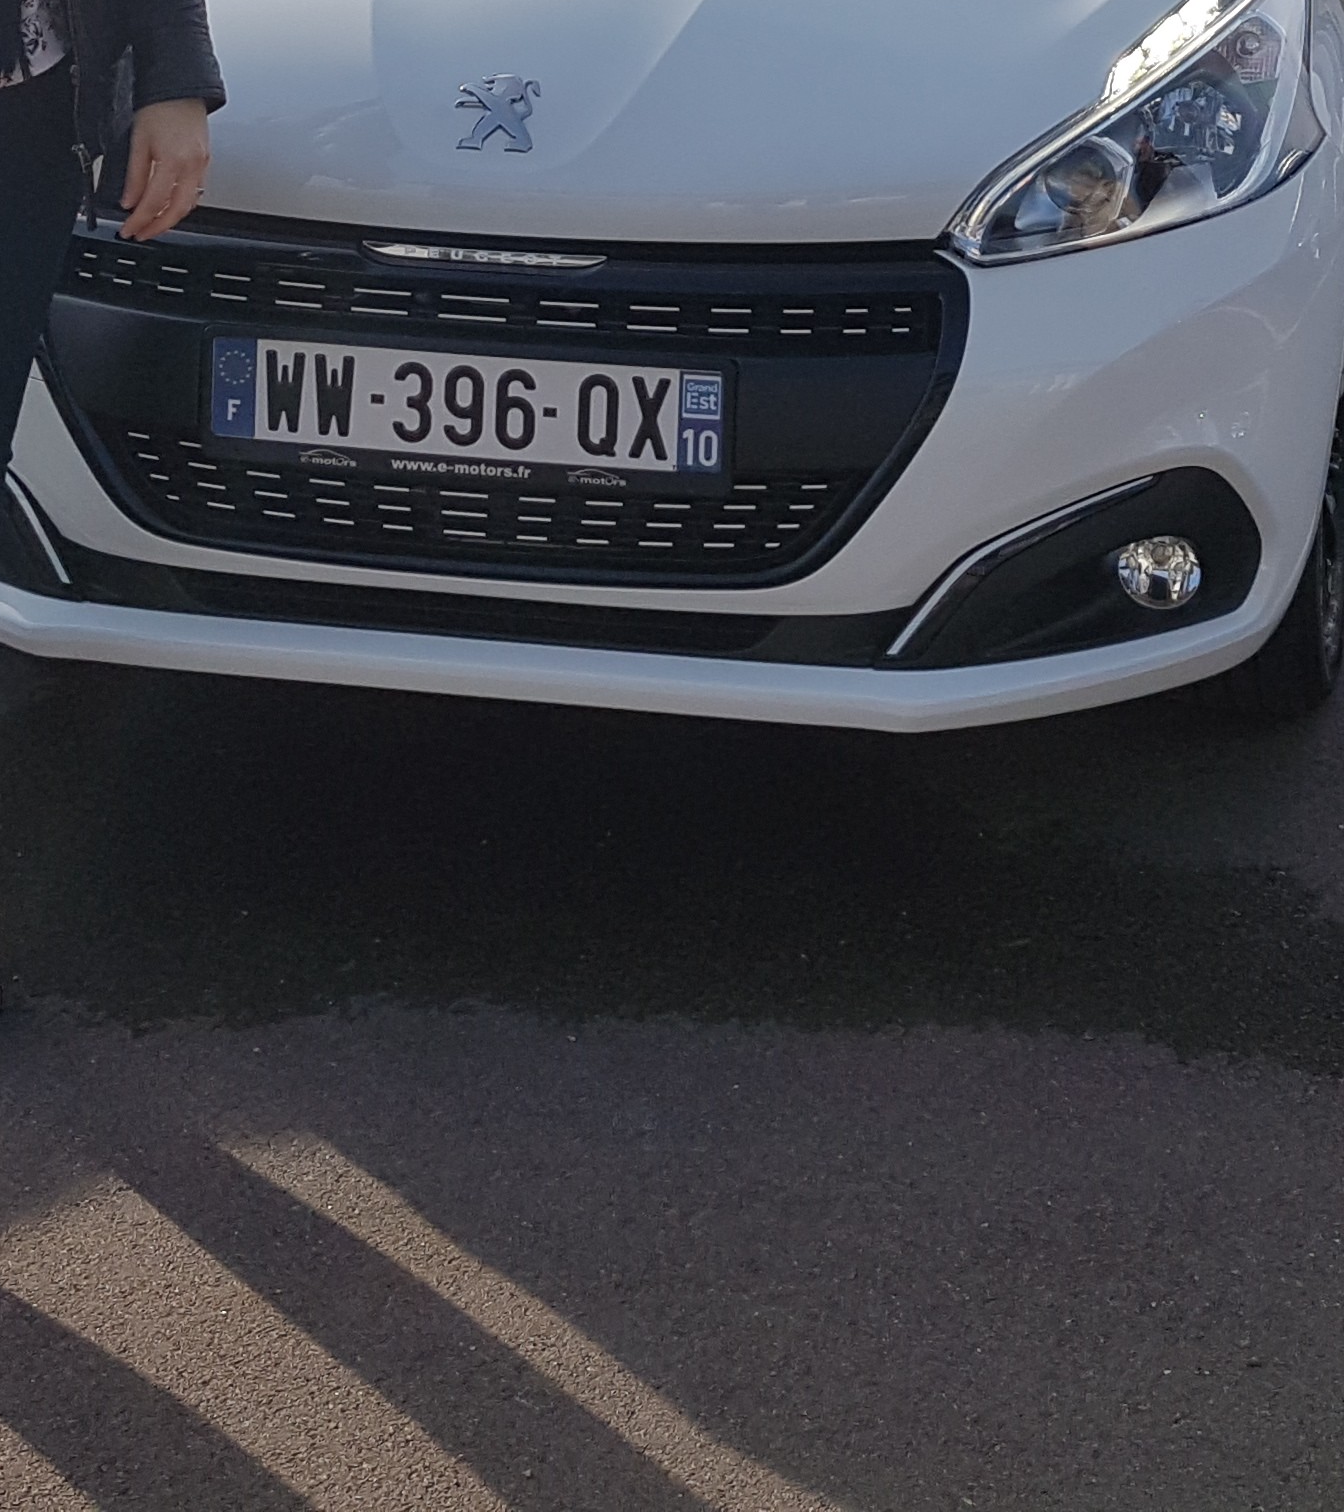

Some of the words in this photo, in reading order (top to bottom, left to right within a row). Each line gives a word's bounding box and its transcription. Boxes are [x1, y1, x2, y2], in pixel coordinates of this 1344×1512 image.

[404, 245, 564, 267] PEUGEOT
[686, 381, 718, 393] Grand
[226, 398, 241, 422] F
[264, 348, 672, 462] WW-396-QX
[686, 391, 717, 411] Est
[682, 428, 719, 467] 10
[391, 458, 532, 480] www.e-motors.fr
